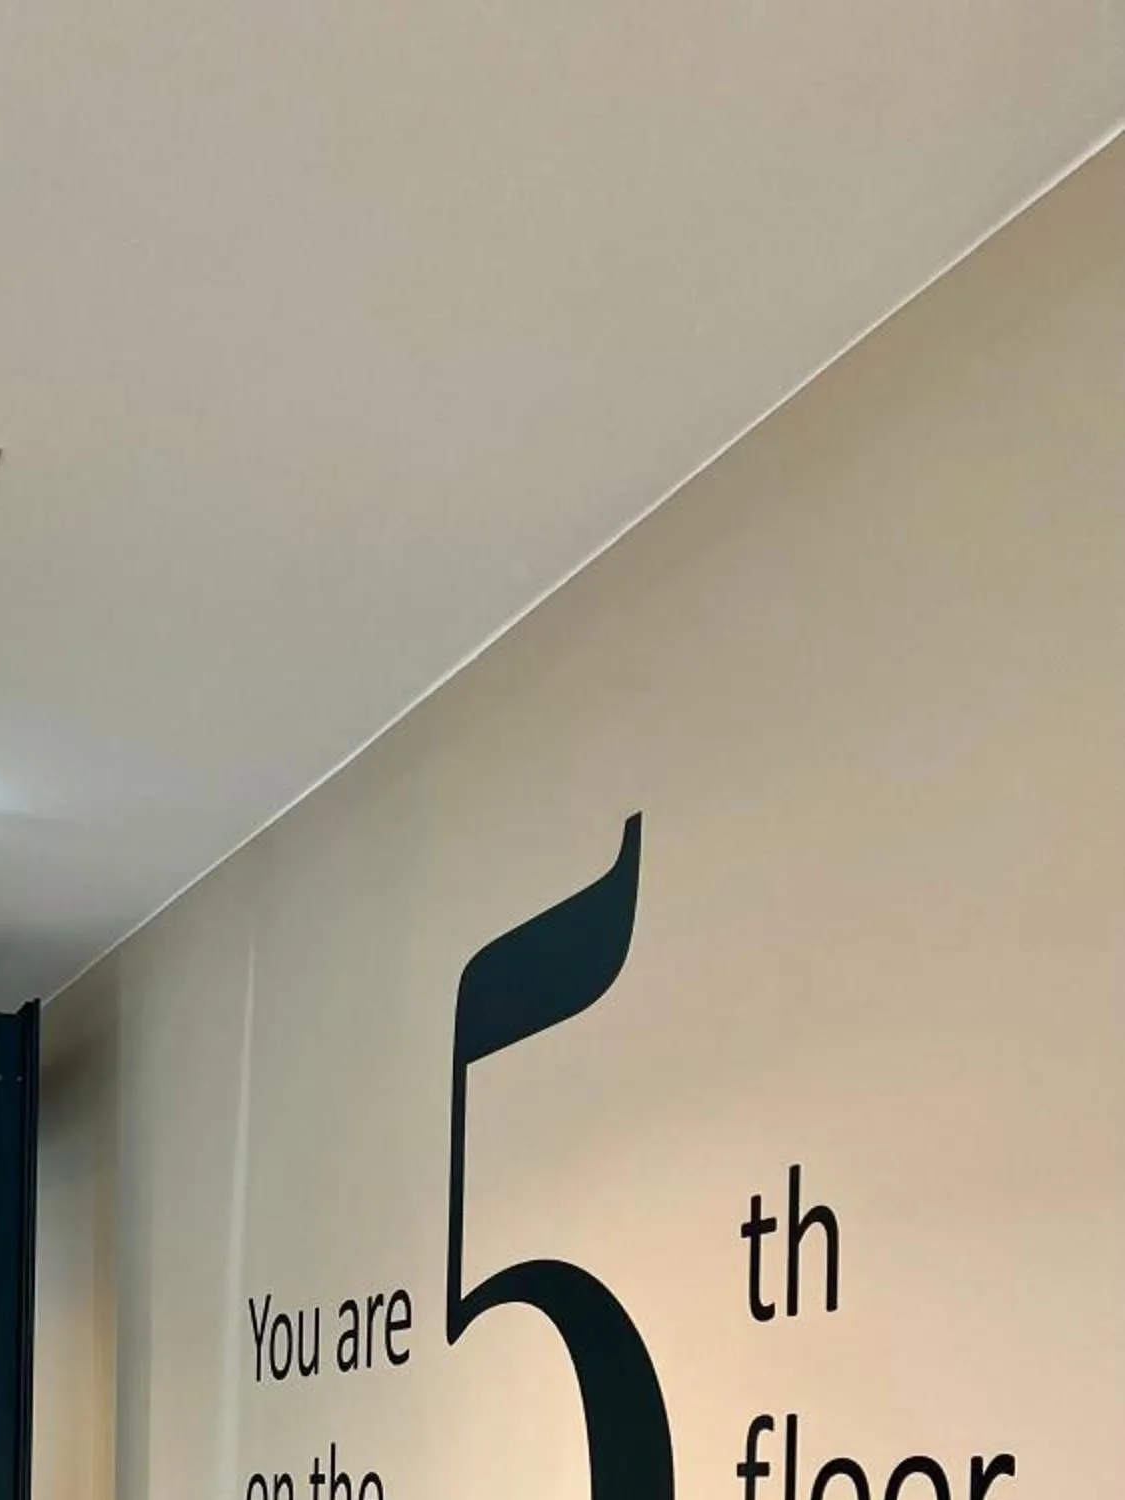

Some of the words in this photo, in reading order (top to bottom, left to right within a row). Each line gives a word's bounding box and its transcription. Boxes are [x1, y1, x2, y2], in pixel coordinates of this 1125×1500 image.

[740, 1164, 839, 1322] th
[248, 1294, 320, 1382] You
[336, 1289, 412, 1373] are
